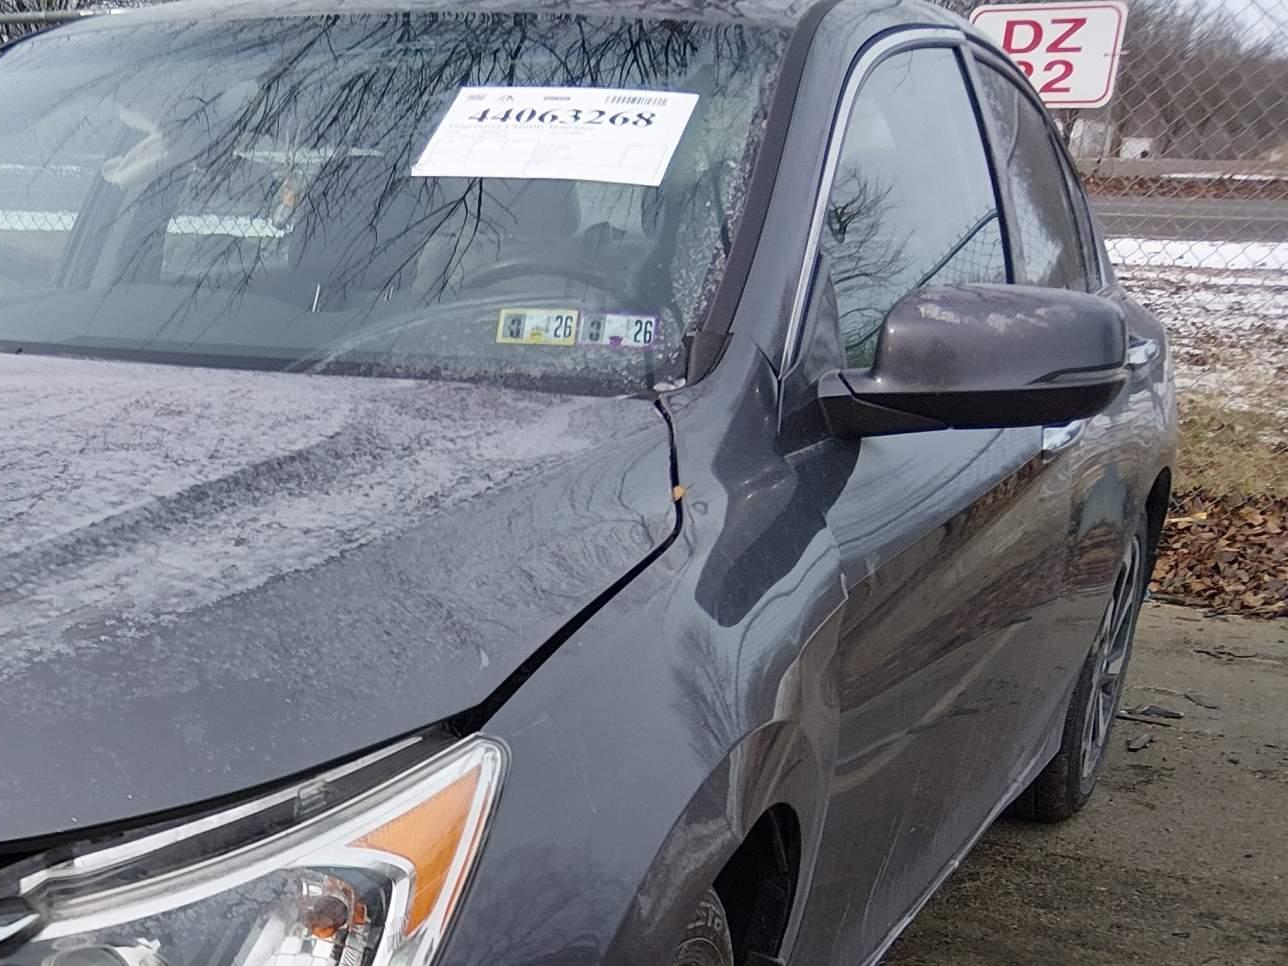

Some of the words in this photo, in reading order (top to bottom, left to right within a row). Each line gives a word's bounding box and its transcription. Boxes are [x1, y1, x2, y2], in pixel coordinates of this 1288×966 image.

[1003, 18, 1087, 54] DZ
[468, 107, 657, 127] 44063268
[554, 314, 574, 338] 26
[633, 319, 654, 344] 26
